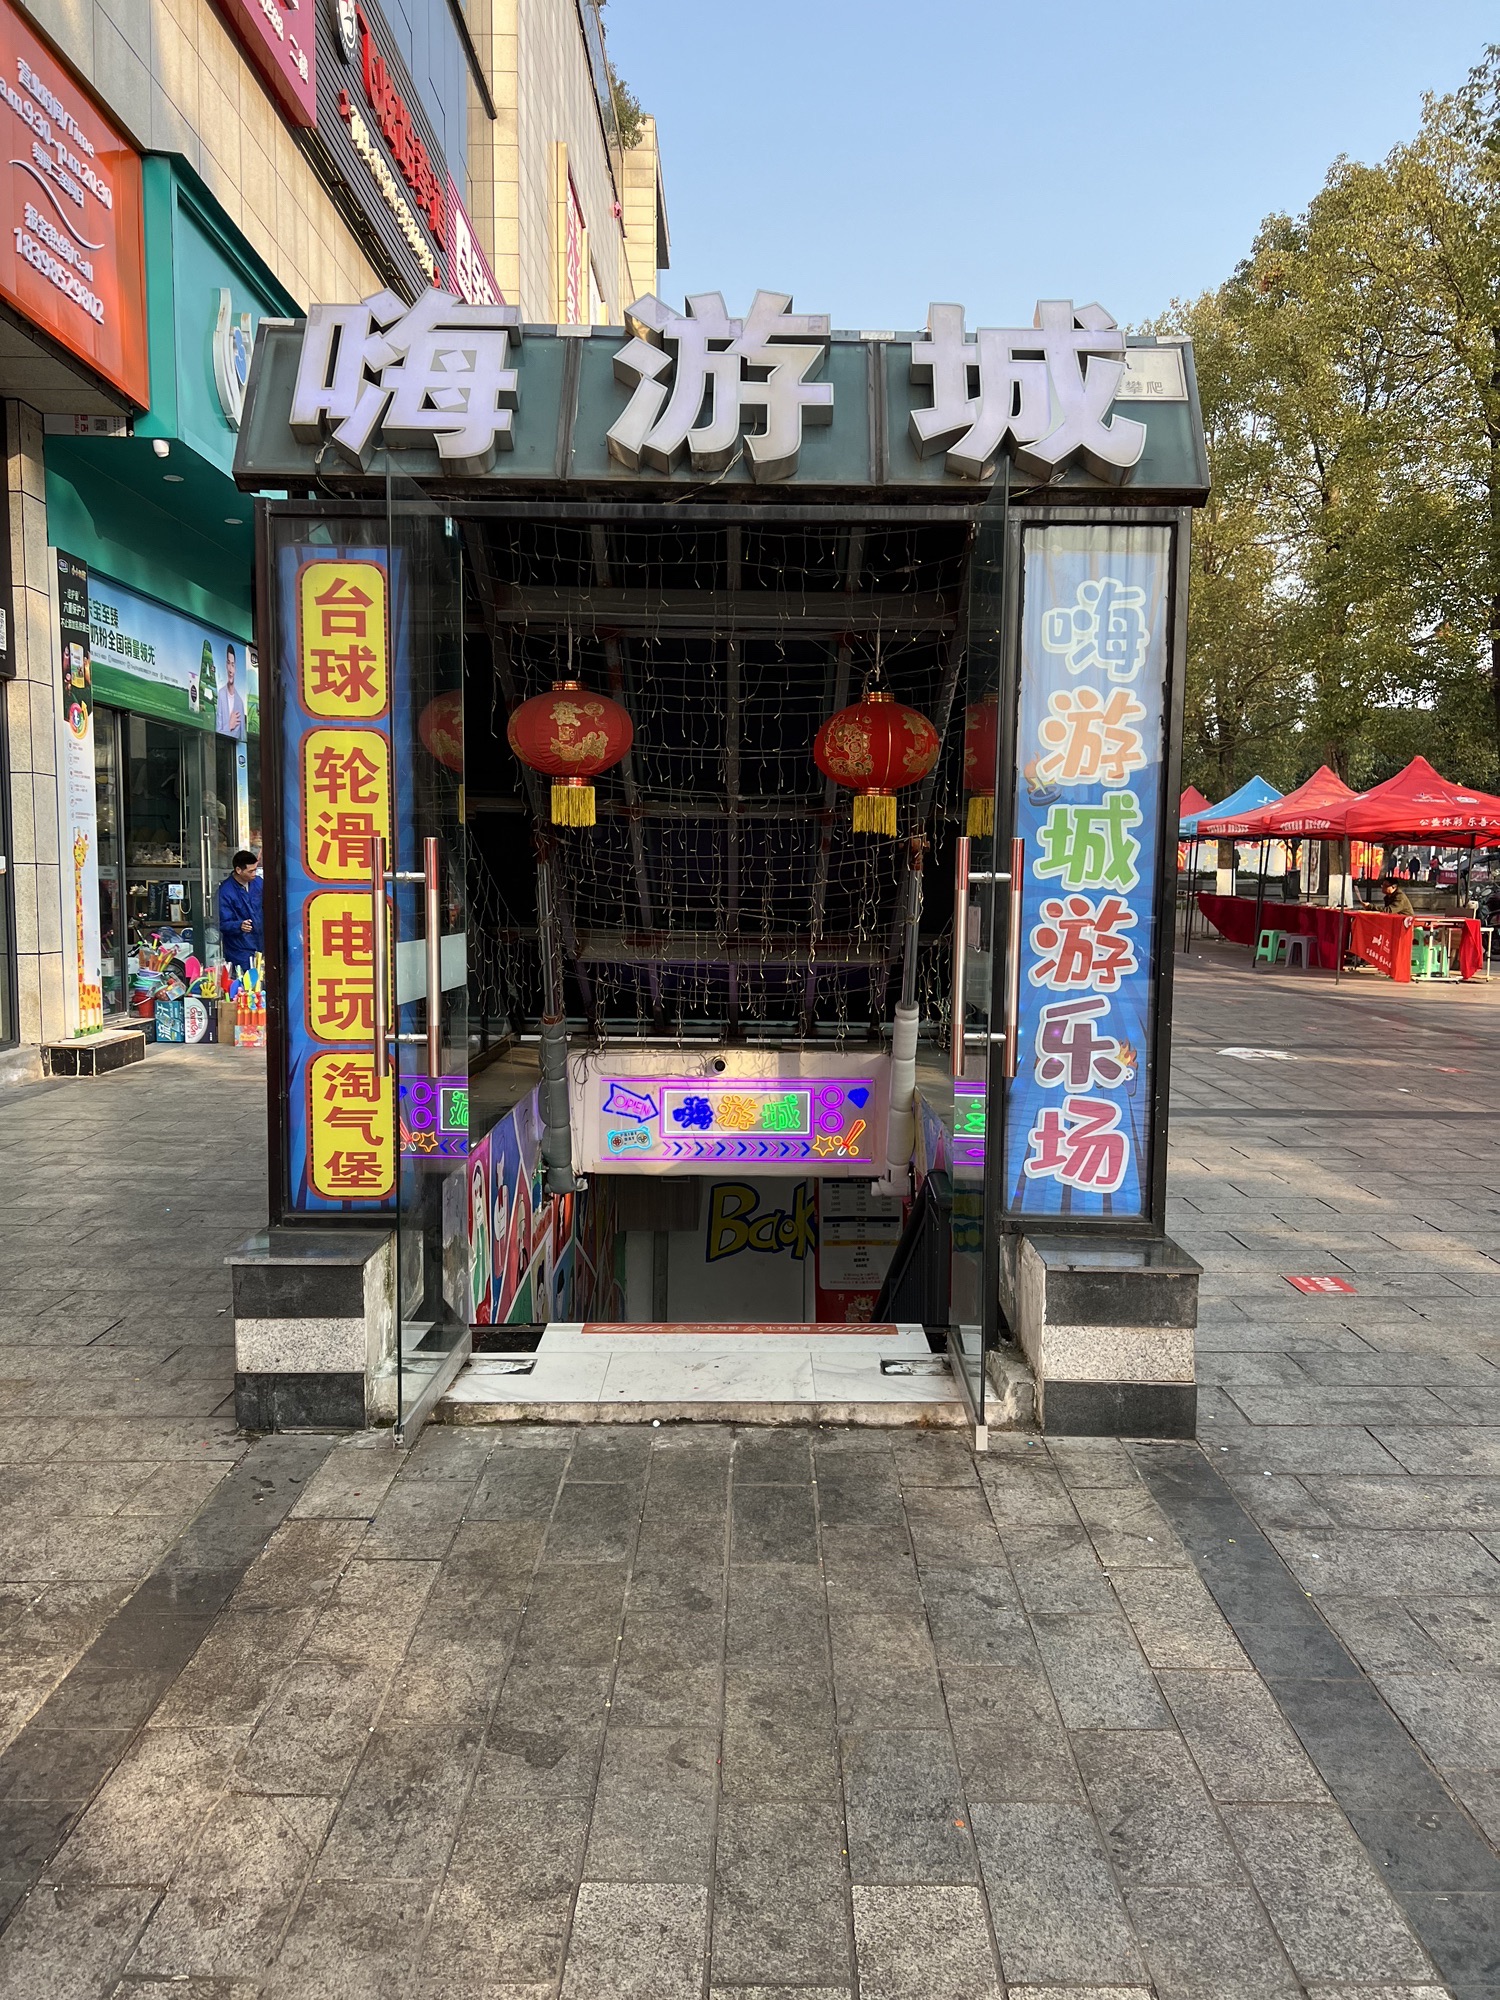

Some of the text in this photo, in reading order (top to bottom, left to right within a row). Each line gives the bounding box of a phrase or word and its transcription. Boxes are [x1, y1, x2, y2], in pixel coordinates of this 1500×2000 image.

[289, 287, 1147, 467] 嗨游城
[310, 578, 380, 703] 台球
[313, 746, 381, 868] 轮滑
[1419, 817, 1463, 827] 公益体彩
[1024, 577, 1150, 1193] 嗨游城游乐场
[317, 911, 375, 1031] 电玩
[322, 1062, 384, 1188] 淘气堡
[613, 1095, 652, 1117] OPEN
[672, 1094, 801, 1131] 嗨游城
